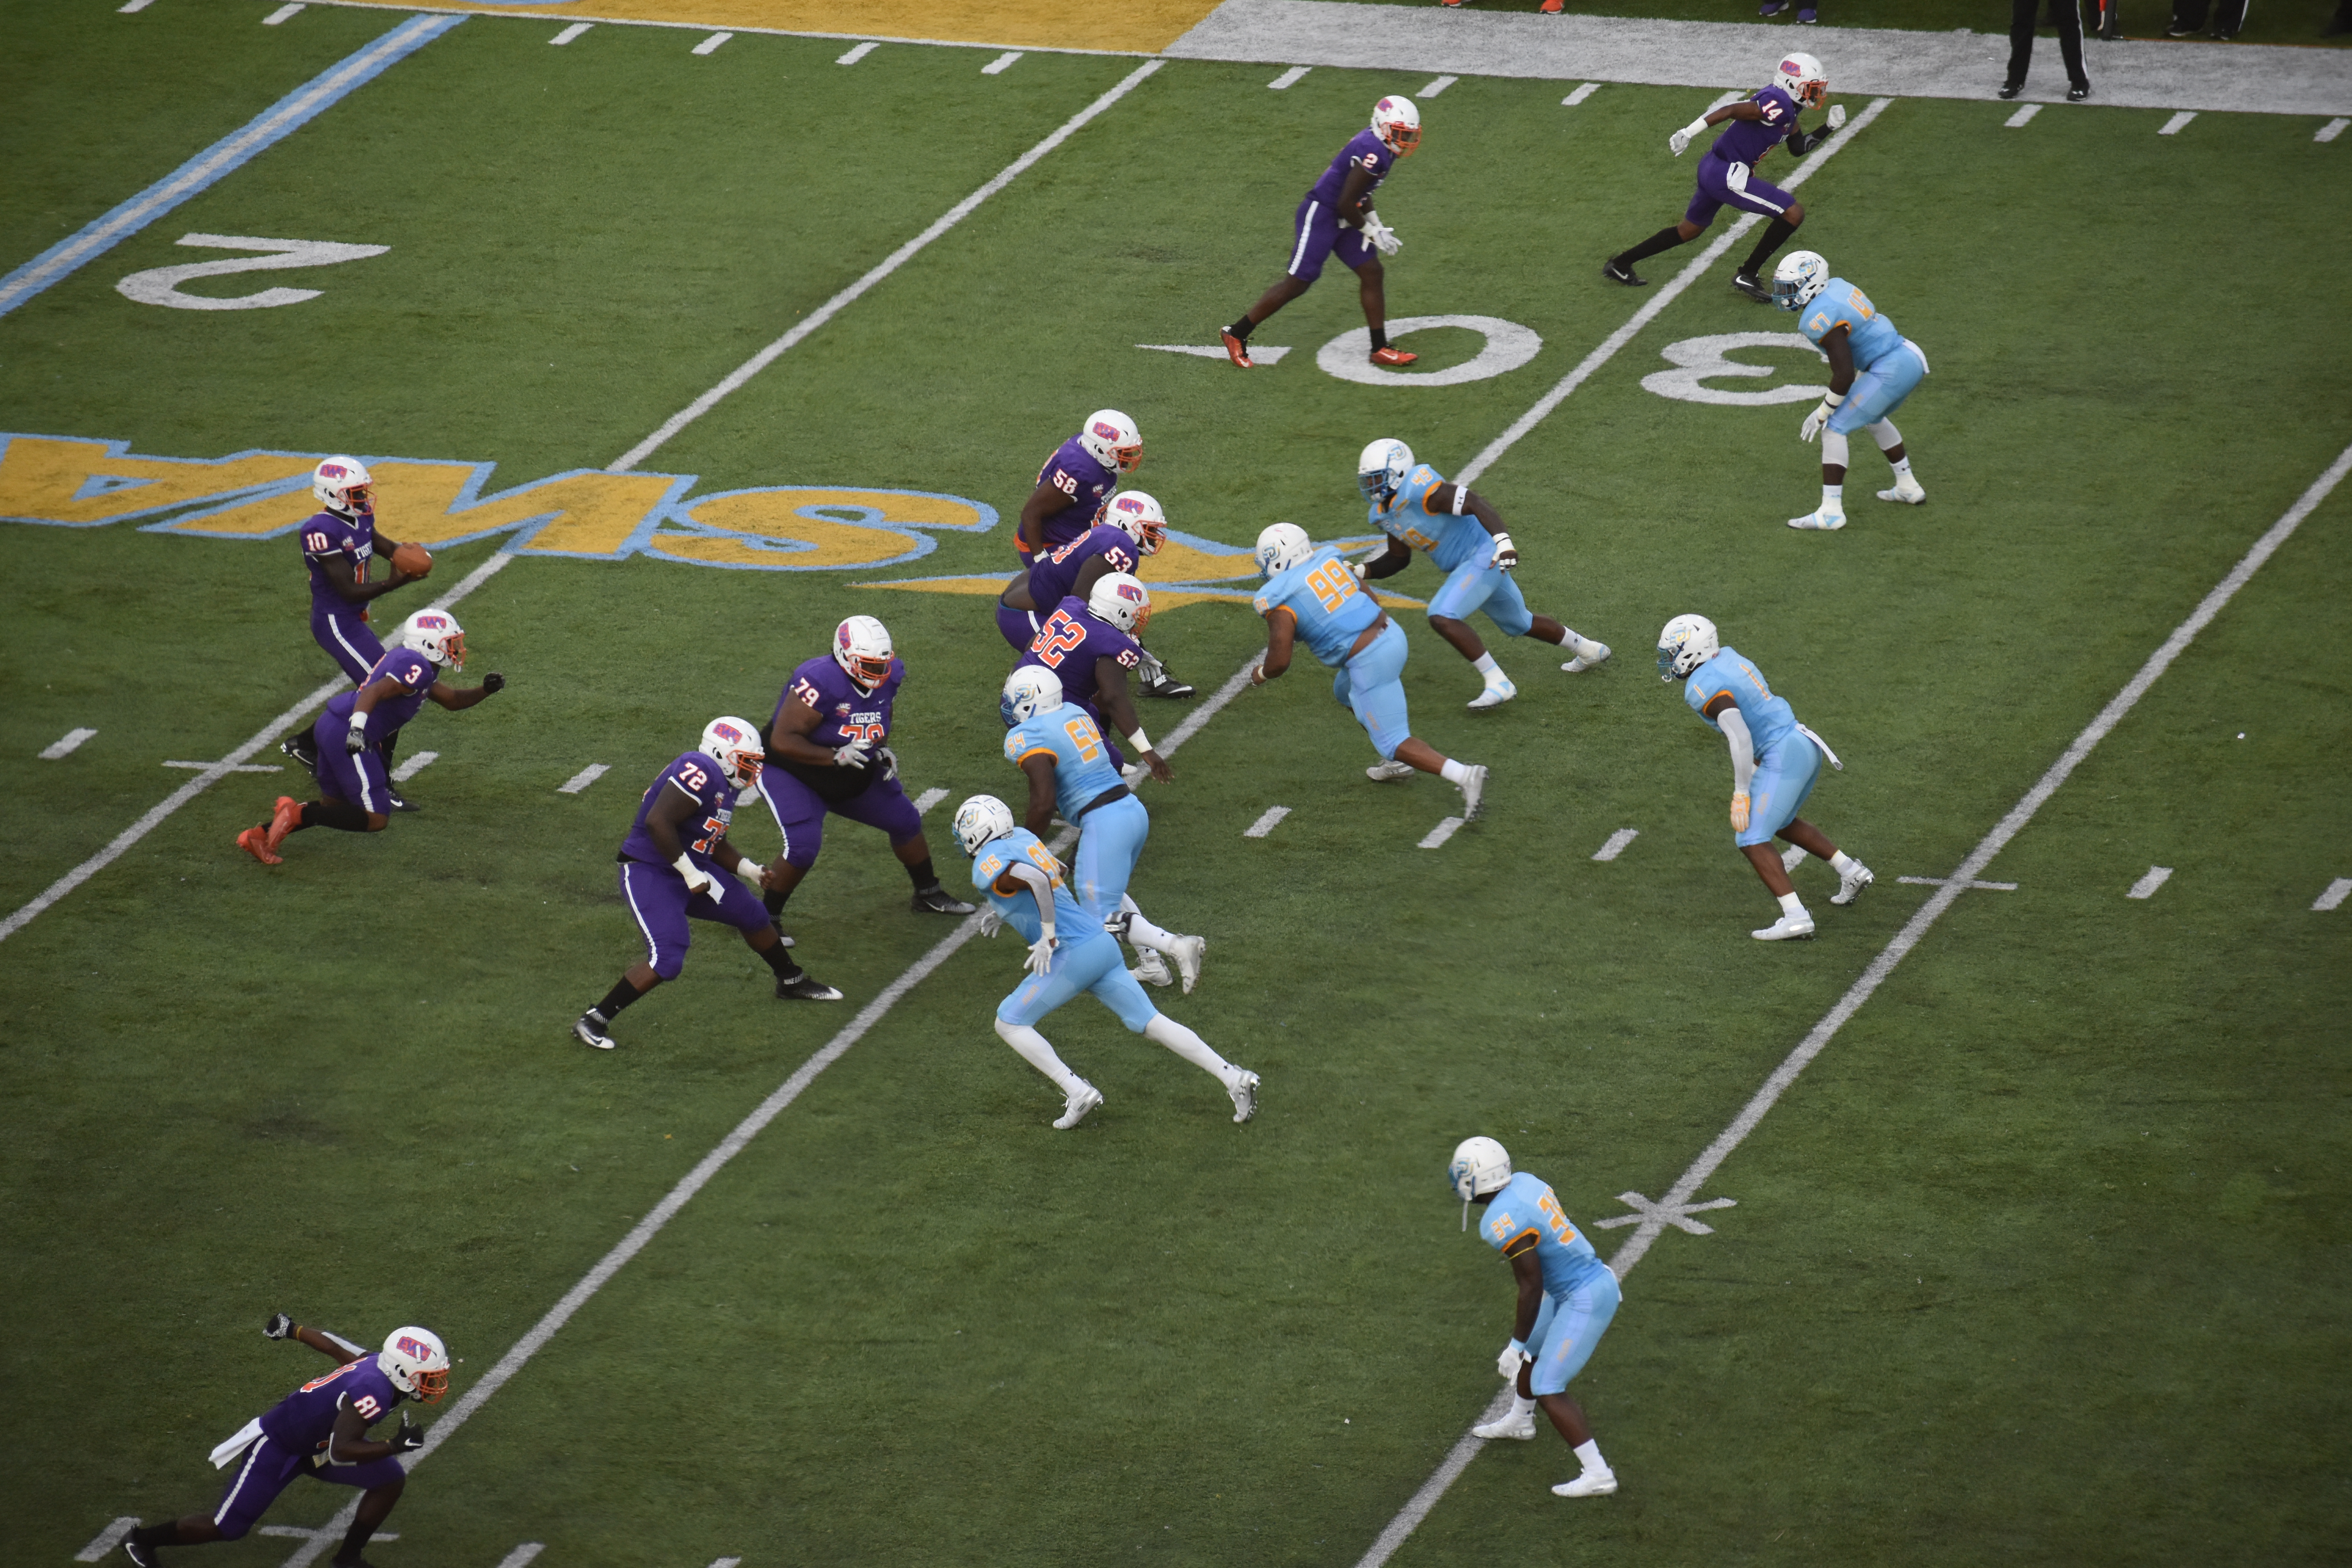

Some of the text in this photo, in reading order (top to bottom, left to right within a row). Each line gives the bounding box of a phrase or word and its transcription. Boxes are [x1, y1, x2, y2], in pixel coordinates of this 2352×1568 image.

[1762, 100, 1783, 121] 14
[1362, 153, 1378, 169] 2
[114, 232, 391, 310] 2
[1809, 312, 1831, 332] 47
[1053, 468, 1078, 494] 58
[307, 532, 328, 552] 10
[1104, 546, 1133, 573] 53
[1304, 559, 1359, 613] 99
[1030, 608, 1087, 669] 52
[1116, 648, 1140, 670] 52
[405, 664, 422, 684] 3
[795, 677, 819, 707] 79
[848, 712, 881, 724] TIGERS
[1007, 733, 1025, 755] 54
[679, 762, 708, 792] 72
[979, 854, 1002, 878] 96
[1491, 1212, 1515, 1240] 34
[354, 1396, 381, 1419] 81
